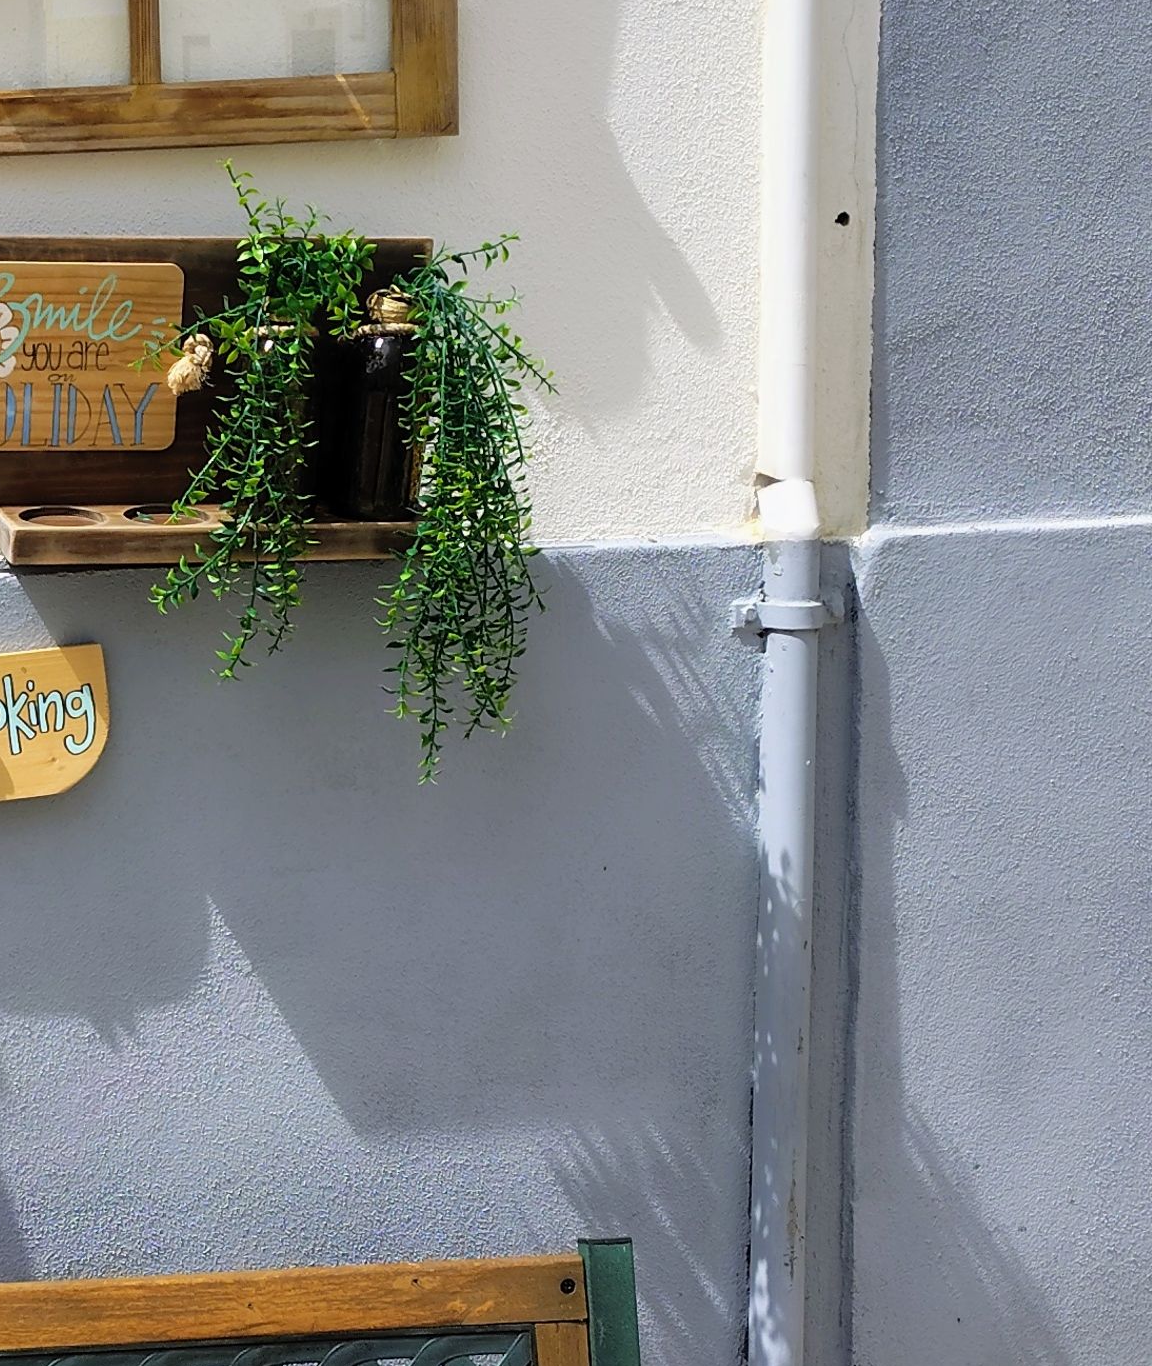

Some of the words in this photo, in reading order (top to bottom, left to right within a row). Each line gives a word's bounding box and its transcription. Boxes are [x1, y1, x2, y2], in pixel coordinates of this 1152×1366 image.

[21, 342, 62, 372] you
[66, 340, 110, 371] are
[48, 373, 77, 383] on
